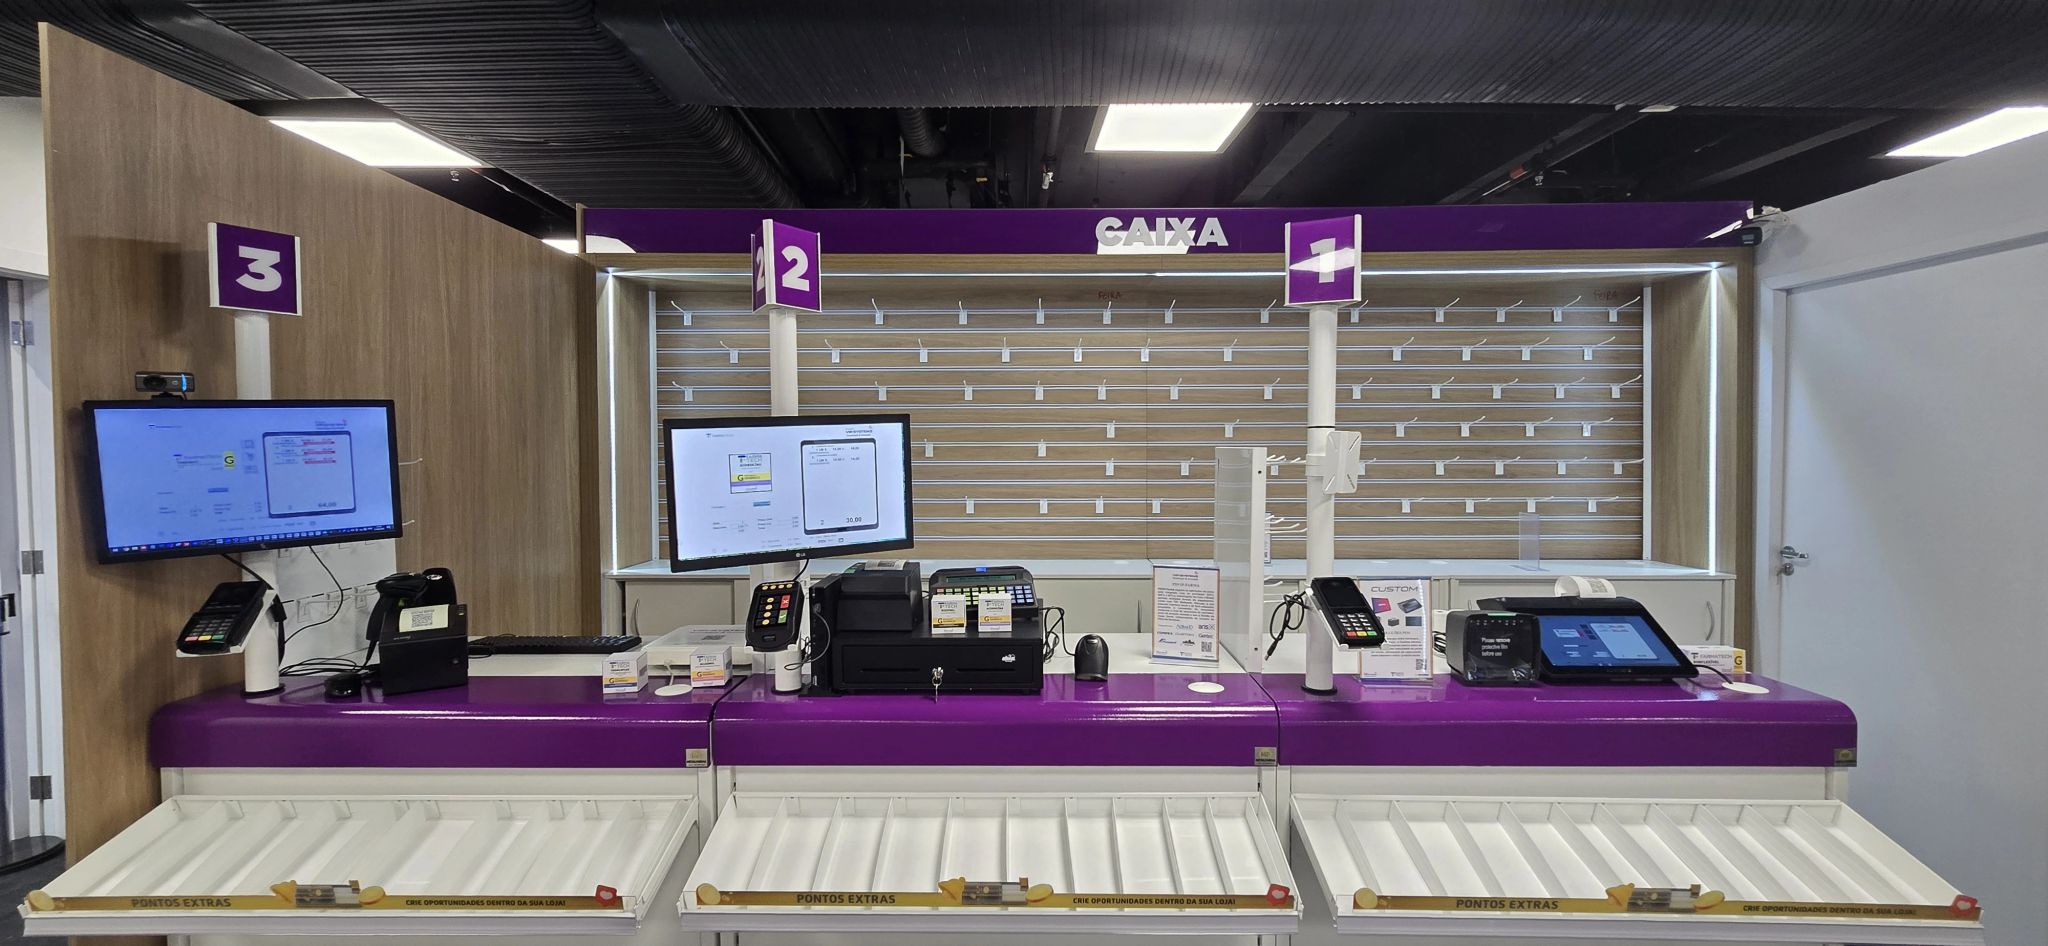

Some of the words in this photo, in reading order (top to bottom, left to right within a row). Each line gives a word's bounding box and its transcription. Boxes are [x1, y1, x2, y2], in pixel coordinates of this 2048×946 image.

[1096, 217, 1229, 247] CAIXA
[235, 245, 282, 292] 3
[756, 246, 765, 292] 2
[781, 245, 810, 292] 2
[1310, 238, 1336, 283] 1
[224, 455, 235, 465] G
[1734, 656, 1743, 665] G
[131, 899, 180, 908] PONTOS
[183, 898, 232, 908] EXTRAS
[797, 894, 844, 904] PONTOS
[848, 894, 896, 904] EXTRAS
[1456, 899, 1505, 908] PONTOS
[1509, 900, 1559, 909] EXTRAS
